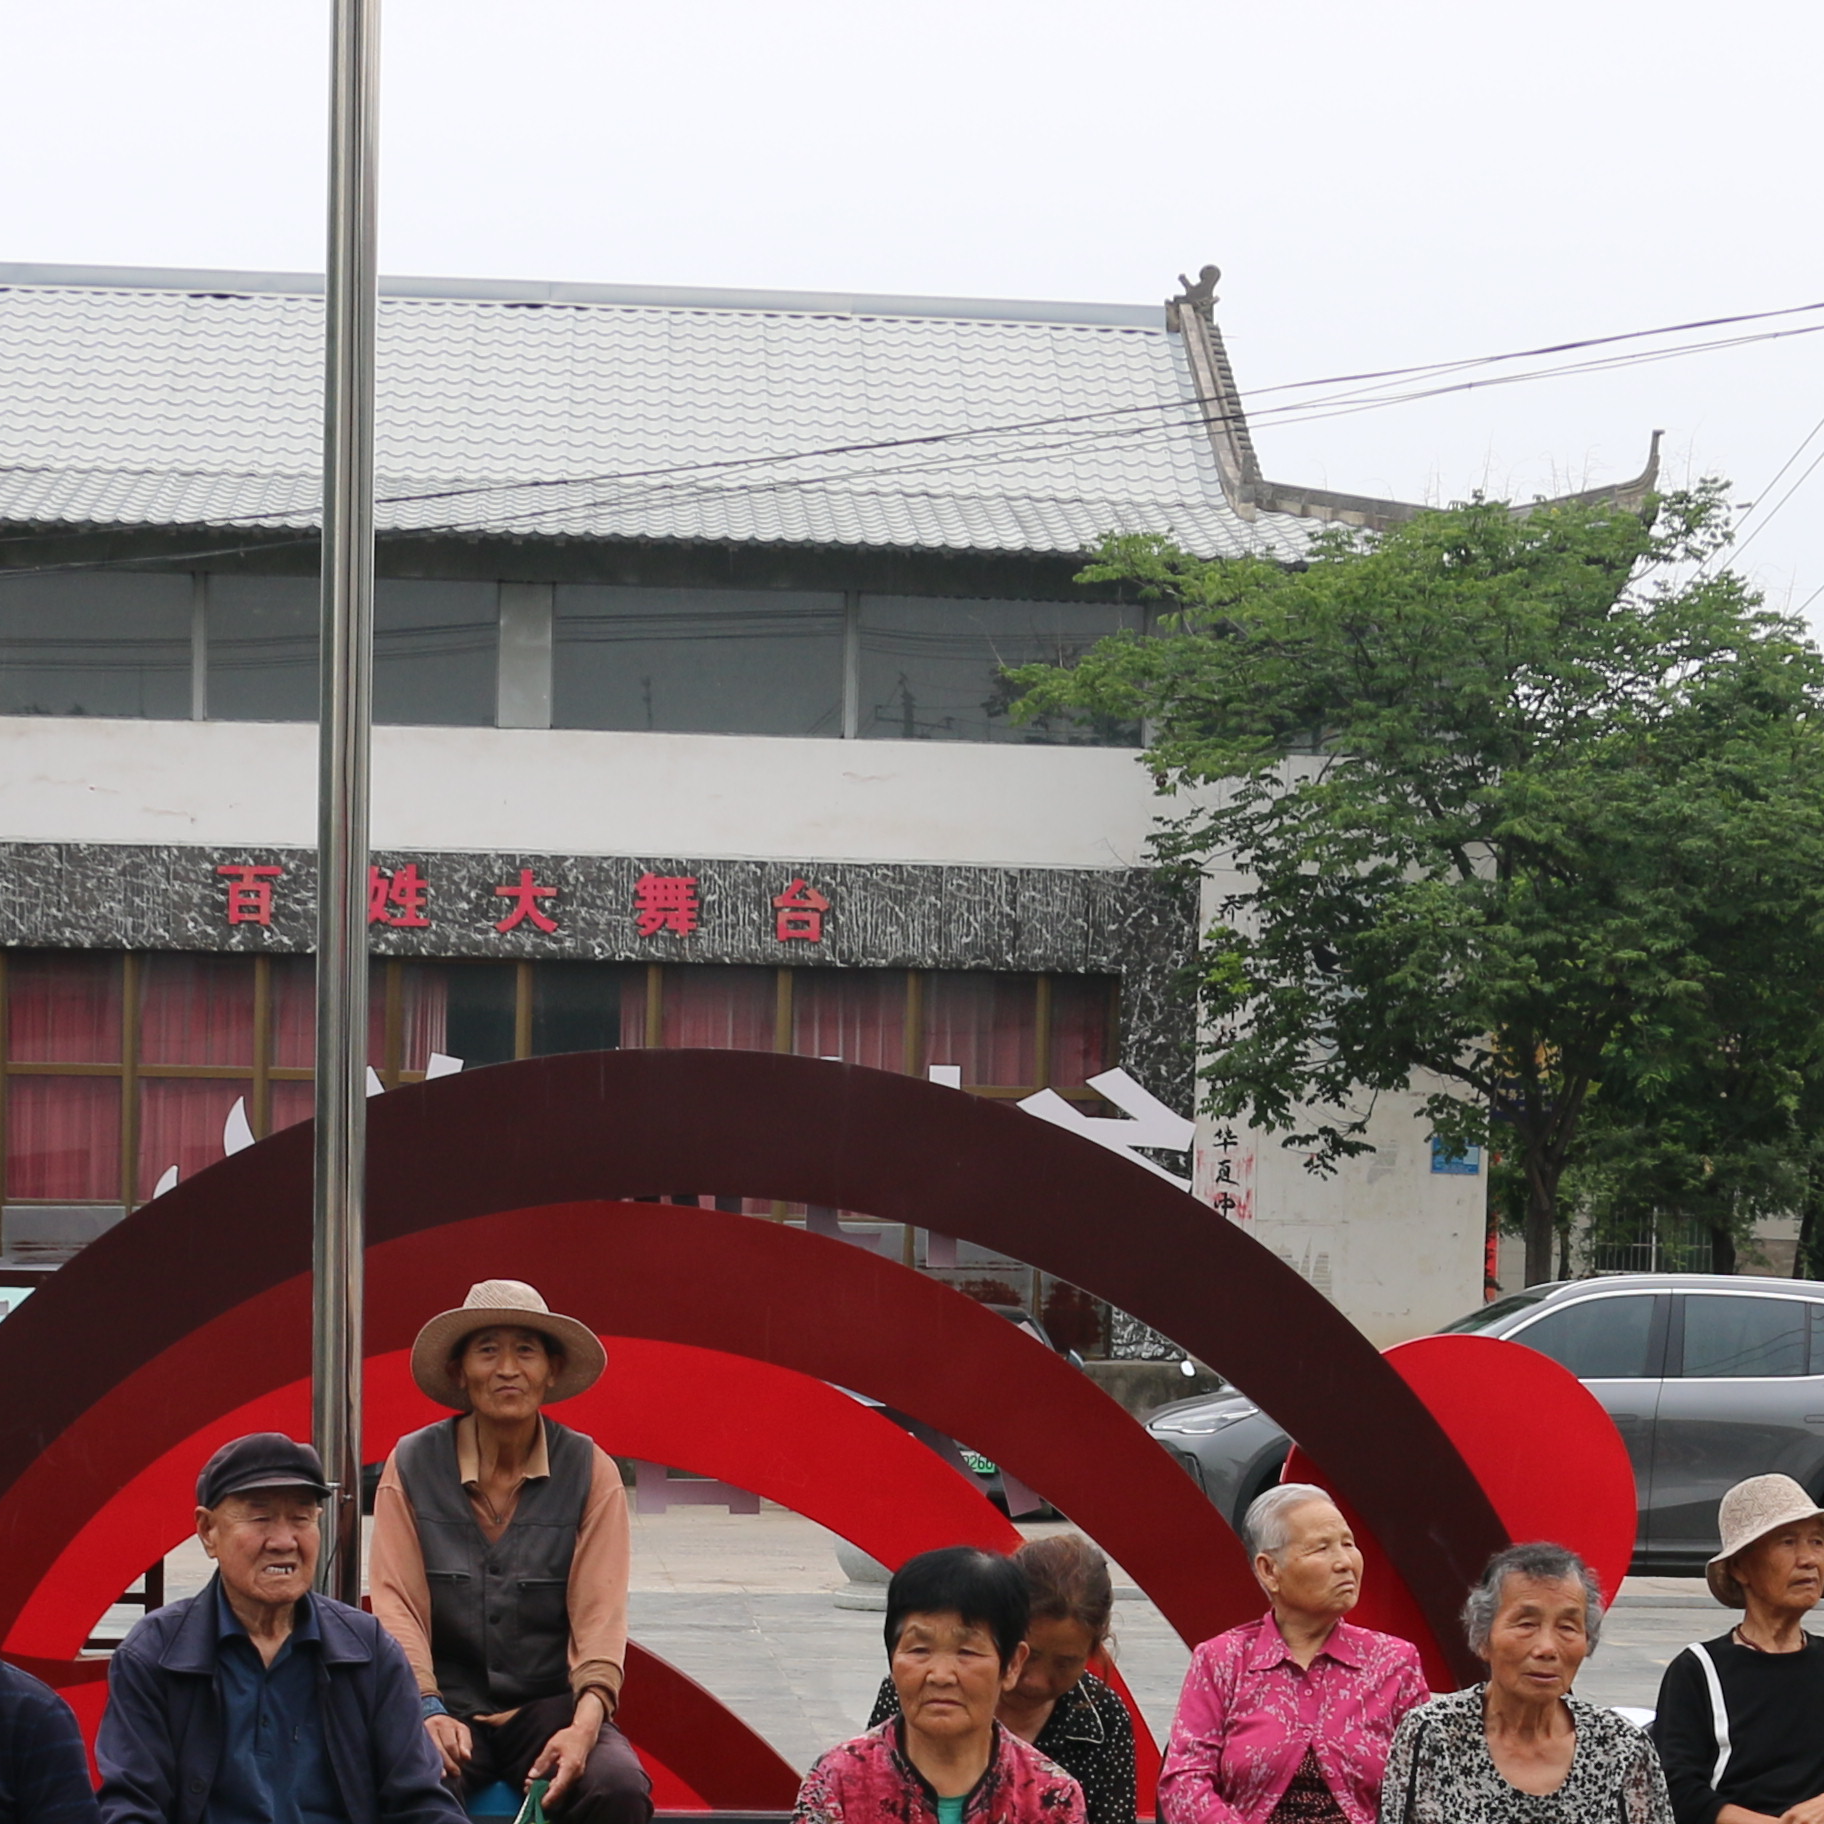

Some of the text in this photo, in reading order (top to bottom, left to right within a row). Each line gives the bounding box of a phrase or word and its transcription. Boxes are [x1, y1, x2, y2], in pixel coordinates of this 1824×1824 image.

[217, 865, 831, 943] 百姓大舞台
